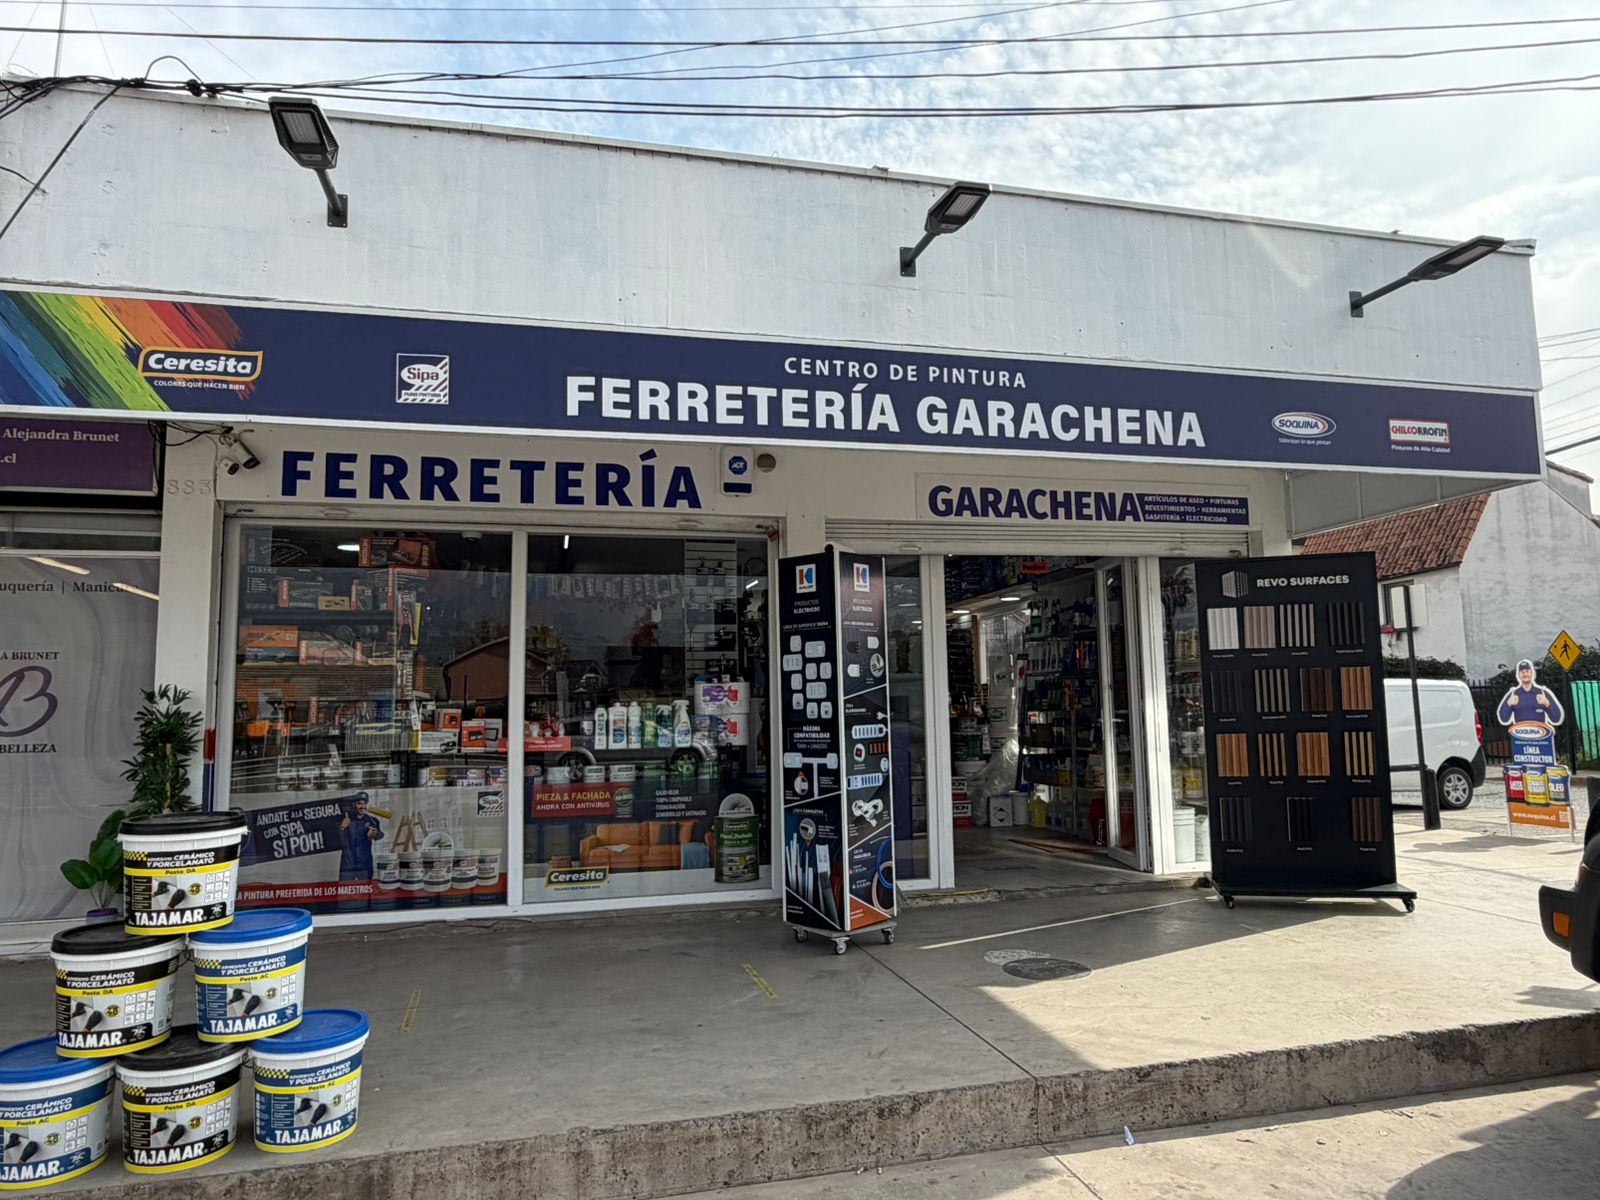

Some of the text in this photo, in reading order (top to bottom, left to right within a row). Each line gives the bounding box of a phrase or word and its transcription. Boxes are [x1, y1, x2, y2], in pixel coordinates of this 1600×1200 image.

[148, 353, 252, 374] Ceresita
[407, 367, 439, 382] Sipa
[784, 357, 1026, 388] CENTRO DE PINTURA
[153, 380, 186, 388] COLORES
[203, 382, 228, 390] HACEN
[566, 376, 1206, 447] FERRETERÍA GARACHENA
[1278, 419, 1320, 429] SOQUINA
[3, 428, 120, 442] Alejandra Brunet
[281, 449, 702, 509] FERRETERÍA
[928, 485, 1142, 522] GARACHENA
[1145, 504, 1247, 514] REVESTIMIENTOS HERRAMIENTAS
[1186, 515, 1228, 523] ELECTRICIDAD
[73, 581, 138, 593] Manic
[1257, 575, 1350, 588] REVO SURFACES
[12, 651, 60, 660] BRUNET
[0, 744, 57, 753] BELLEZA
[1523, 745, 1540, 754] LÍNEA
[1513, 755, 1553, 764] CONSTRUCTOR
[536, 793, 561, 802] PIEZA
[571, 791, 611, 800] FACHADA
[303, 803, 341, 821] SEGURA
[536, 803, 560, 811] AHORA
[577, 801, 610, 809] ANTIVIRUS
[263, 821, 305, 839] CON SIPA
[289, 831, 325, 855] POH!
[152, 857, 215, 868] PORCELANATO
[173, 851, 215, 861] CERÁMICO
[550, 870, 604, 882] Ceresita
[243, 890, 274, 900] PINTURA
[275, 888, 313, 898] PREFERIDA
[313, 887, 323, 896] DE
[324, 886, 337, 896] LOS
[337, 885, 373, 895] MAESTROS
[135, 908, 204, 927] TAJAMAR
[226, 961, 286, 976] PORCELANATO
[247, 955, 286, 968] CERÁMICO
[71, 977, 135, 988] PORCELANATO
[90, 971, 135, 981] CERÁMICO
[210, 1012, 278, 1033] TAJAMAR
[58, 1031, 122, 1048] TAJAMAR
[316, 1061, 351, 1076] CERÁMICO
[295, 1067, 351, 1086] PORCELANATO
[172, 1081, 215, 1095] CERÁMICO
[151, 1087, 215, 1104] PORCELANATO
[4, 1103, 73, 1118] PORCELANATO
[25, 1097, 73, 1111] CERÁMICO
[275, 1119, 341, 1144] TAJAMAR
[133, 1142, 205, 1165] TAJAMAR
[0, 1160, 61, 1181] JAMAR
